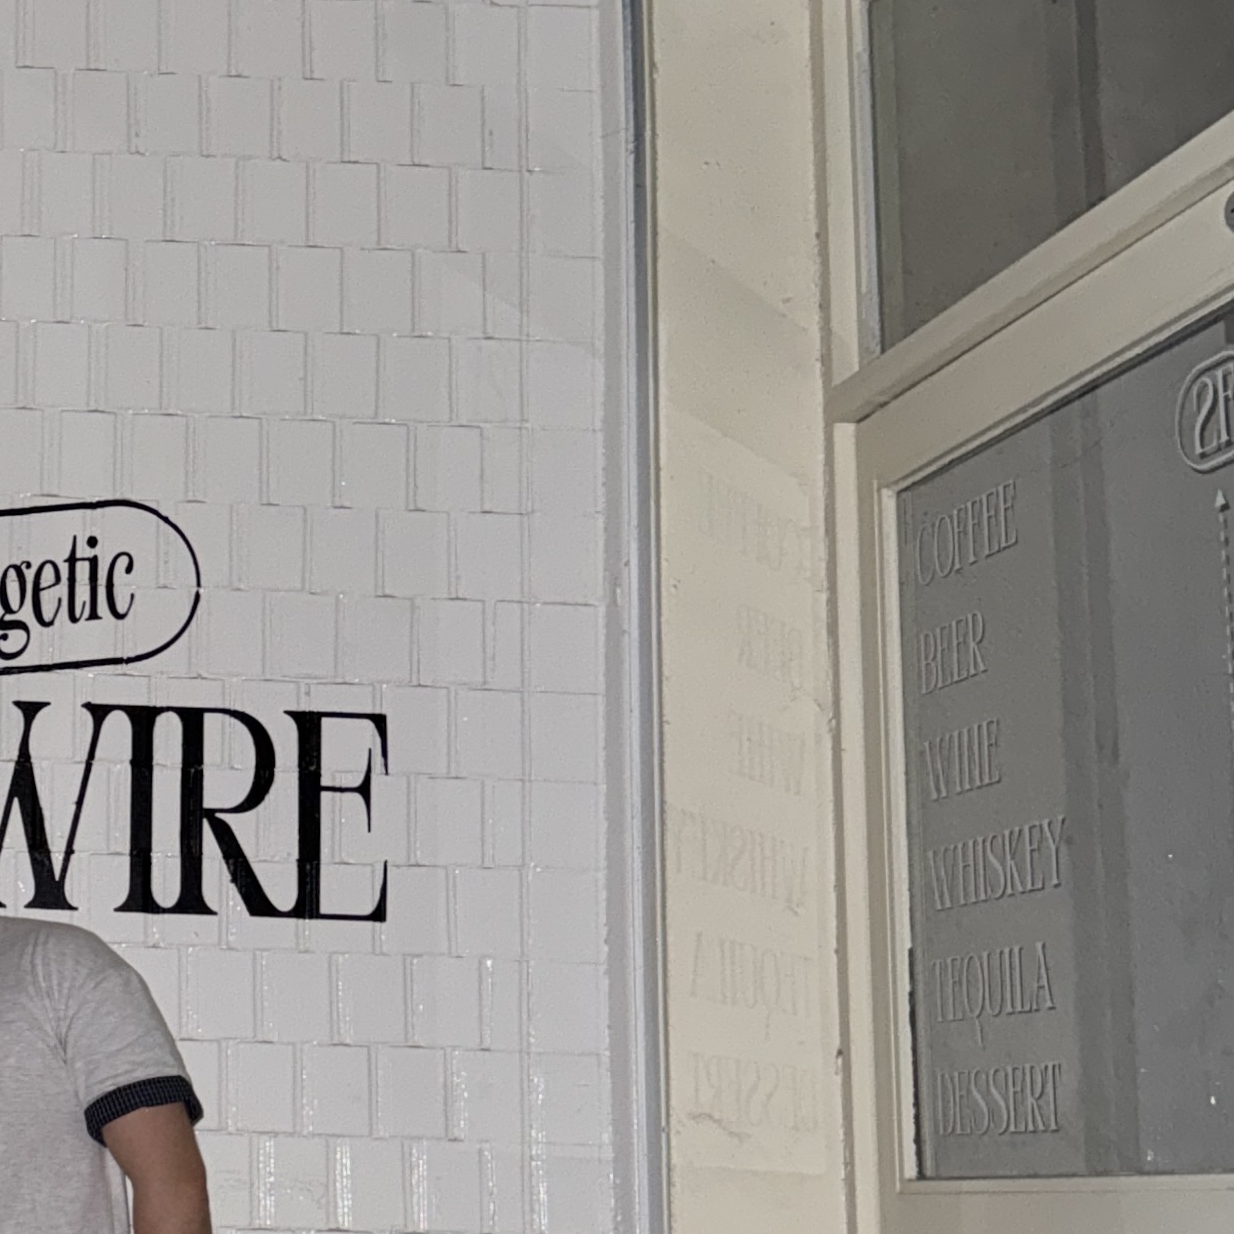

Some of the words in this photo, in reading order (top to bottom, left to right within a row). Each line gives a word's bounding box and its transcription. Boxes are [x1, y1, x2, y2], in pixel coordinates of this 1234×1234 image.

[917, 480, 1018, 586] COFFEE
[920, 611, 988, 695] BEER
[923, 717, 1002, 802] WINE
[928, 815, 1066, 911] WHISKEY
[932, 941, 1057, 1051] TEQUILA
[935, 1063, 1063, 1136] DESSERT
